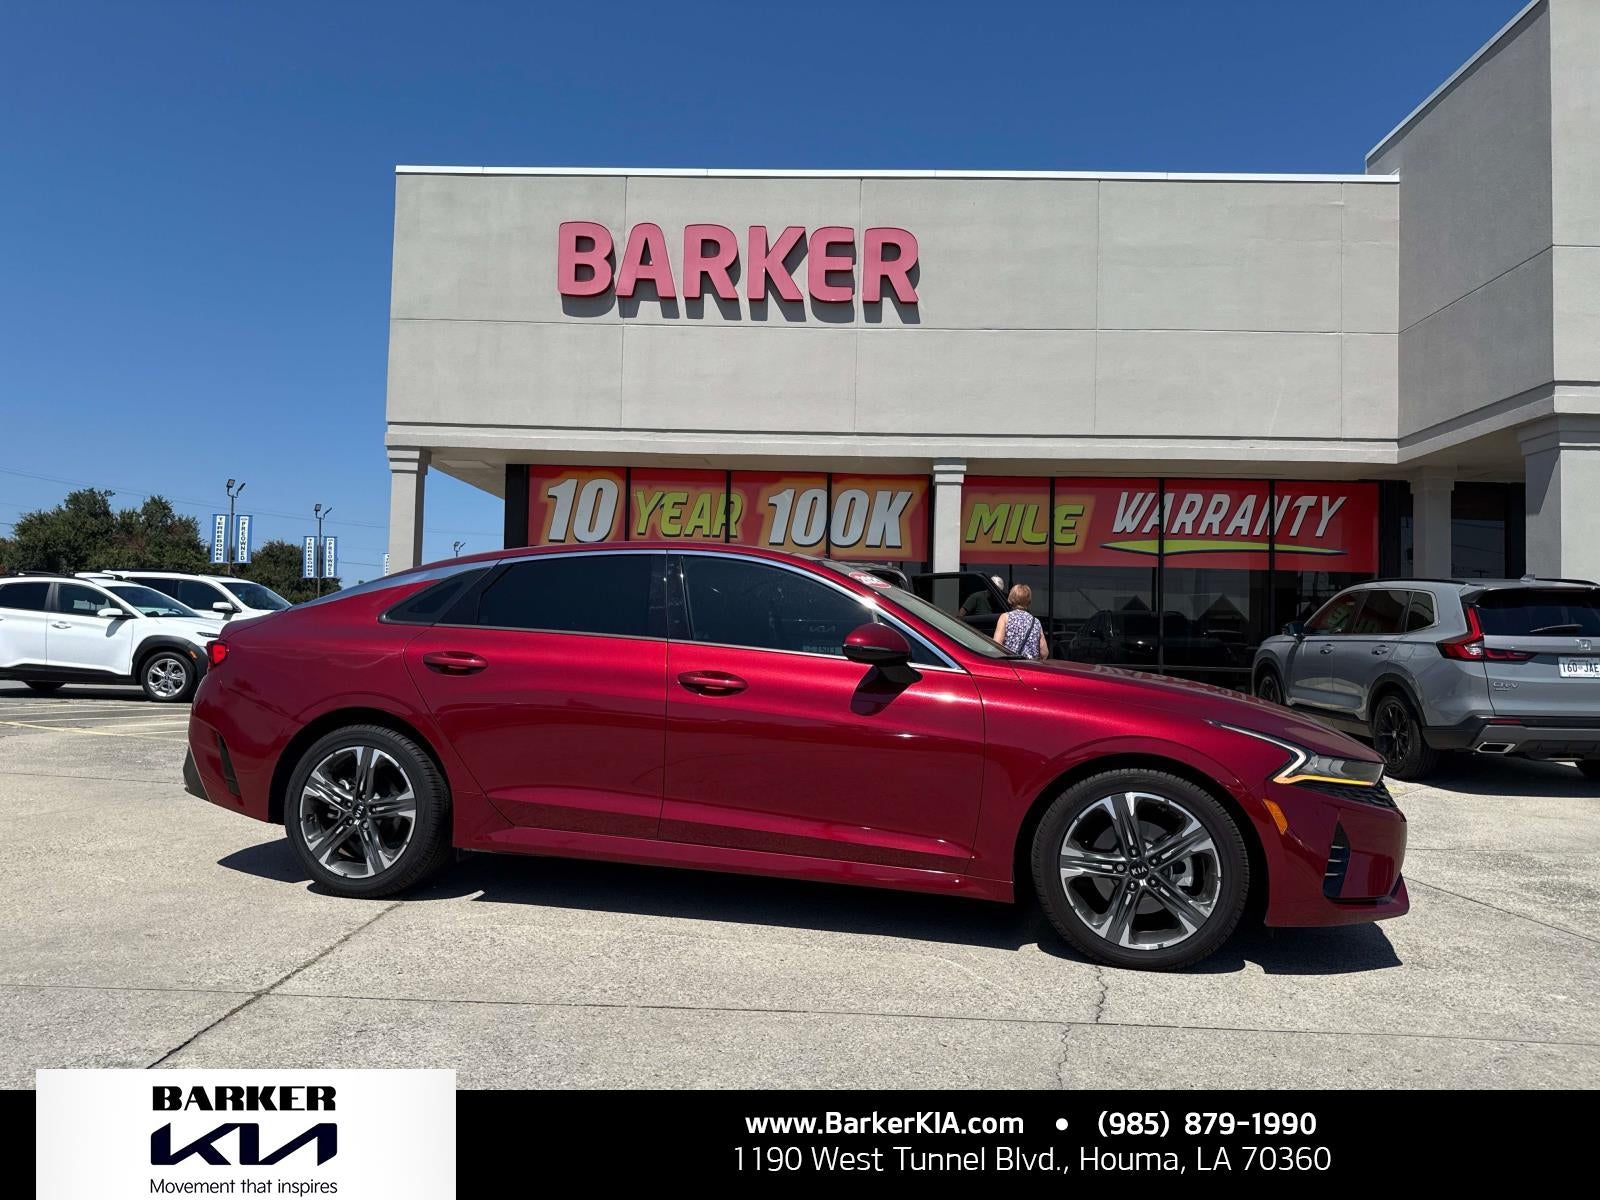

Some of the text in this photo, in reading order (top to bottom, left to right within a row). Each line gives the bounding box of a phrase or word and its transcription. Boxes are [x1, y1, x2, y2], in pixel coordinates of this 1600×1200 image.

[557, 221, 919, 303] BARKER
[547, 478, 1347, 548] 10 YEAR 100K MILE WARRANTY
[1131, 866, 1148, 875] KIA
